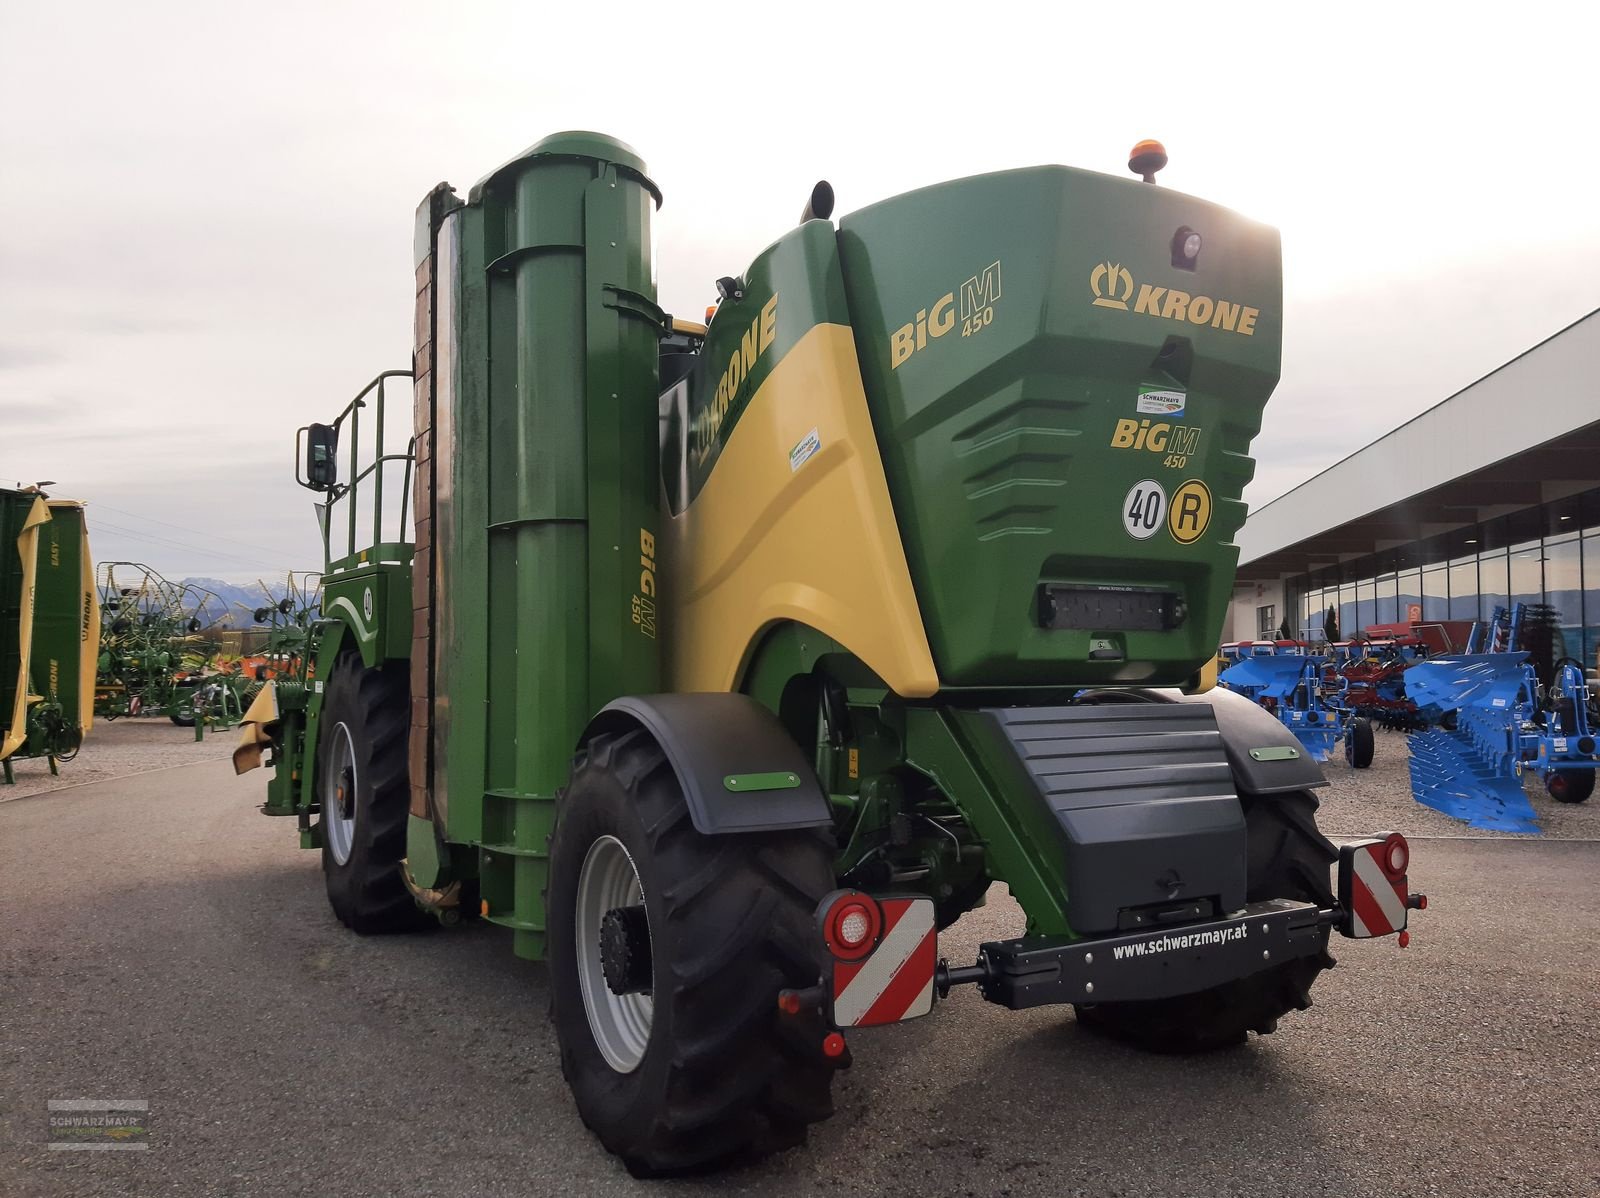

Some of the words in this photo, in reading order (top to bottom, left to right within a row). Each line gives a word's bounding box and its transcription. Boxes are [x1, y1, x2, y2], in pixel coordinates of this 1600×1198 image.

[961, 305, 994, 338] 450
[1134, 285, 1260, 336] KRONE
[710, 292, 779, 446] KRONE
[1163, 455, 1187, 469] 450
[1128, 490, 1159, 530] 40
[1178, 492, 1202, 532] R
[51, 541, 60, 567] EASY
[83, 592, 92, 631] KRONE
[631, 594, 641, 625] 450
[50, 658, 59, 695] RONE
[1113, 922, 1248, 960] www.schwarzmayr.at
